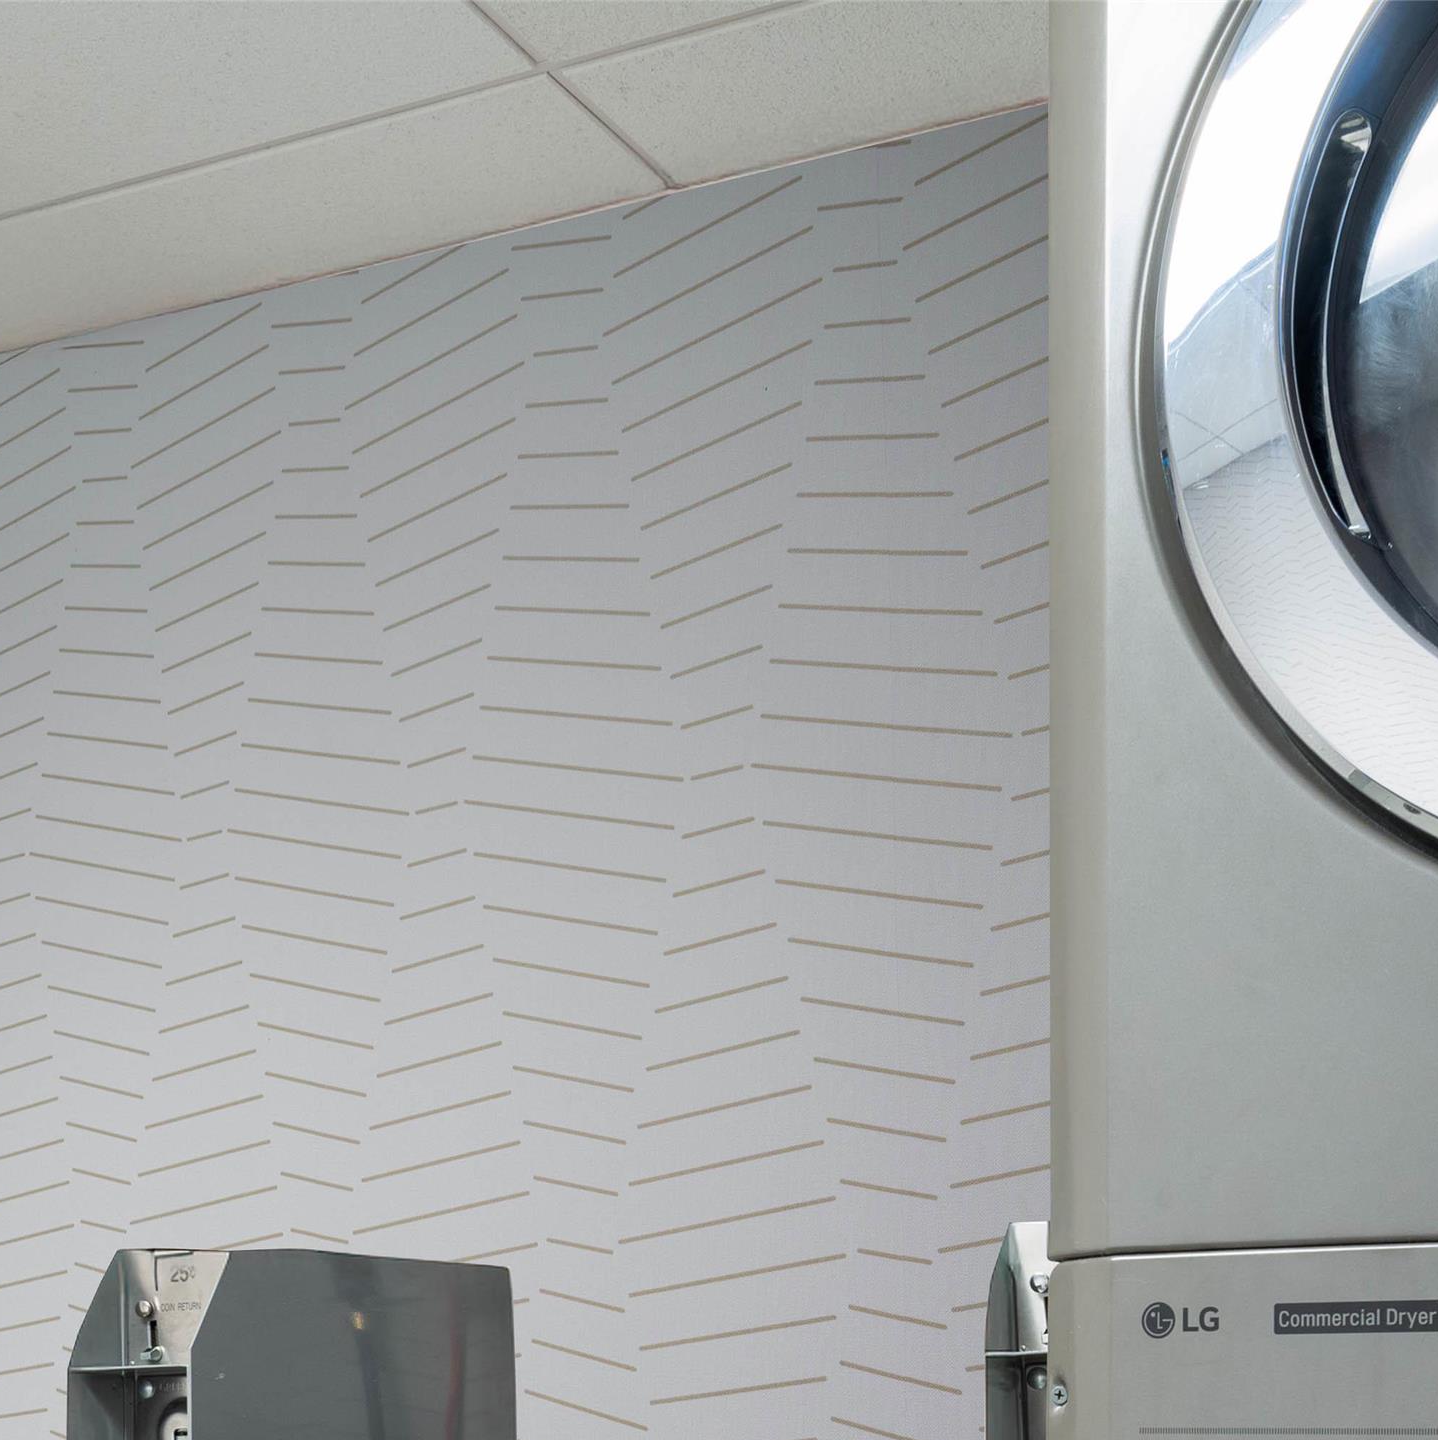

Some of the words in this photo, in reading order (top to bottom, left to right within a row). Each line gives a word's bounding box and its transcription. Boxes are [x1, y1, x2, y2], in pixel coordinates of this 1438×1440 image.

[178, 1302, 202, 1312] RETURN
[1182, 1306, 1220, 1332] LG
[1278, 1309, 1381, 1328] Commercial
[1386, 1308, 1437, 1328] Dryer
